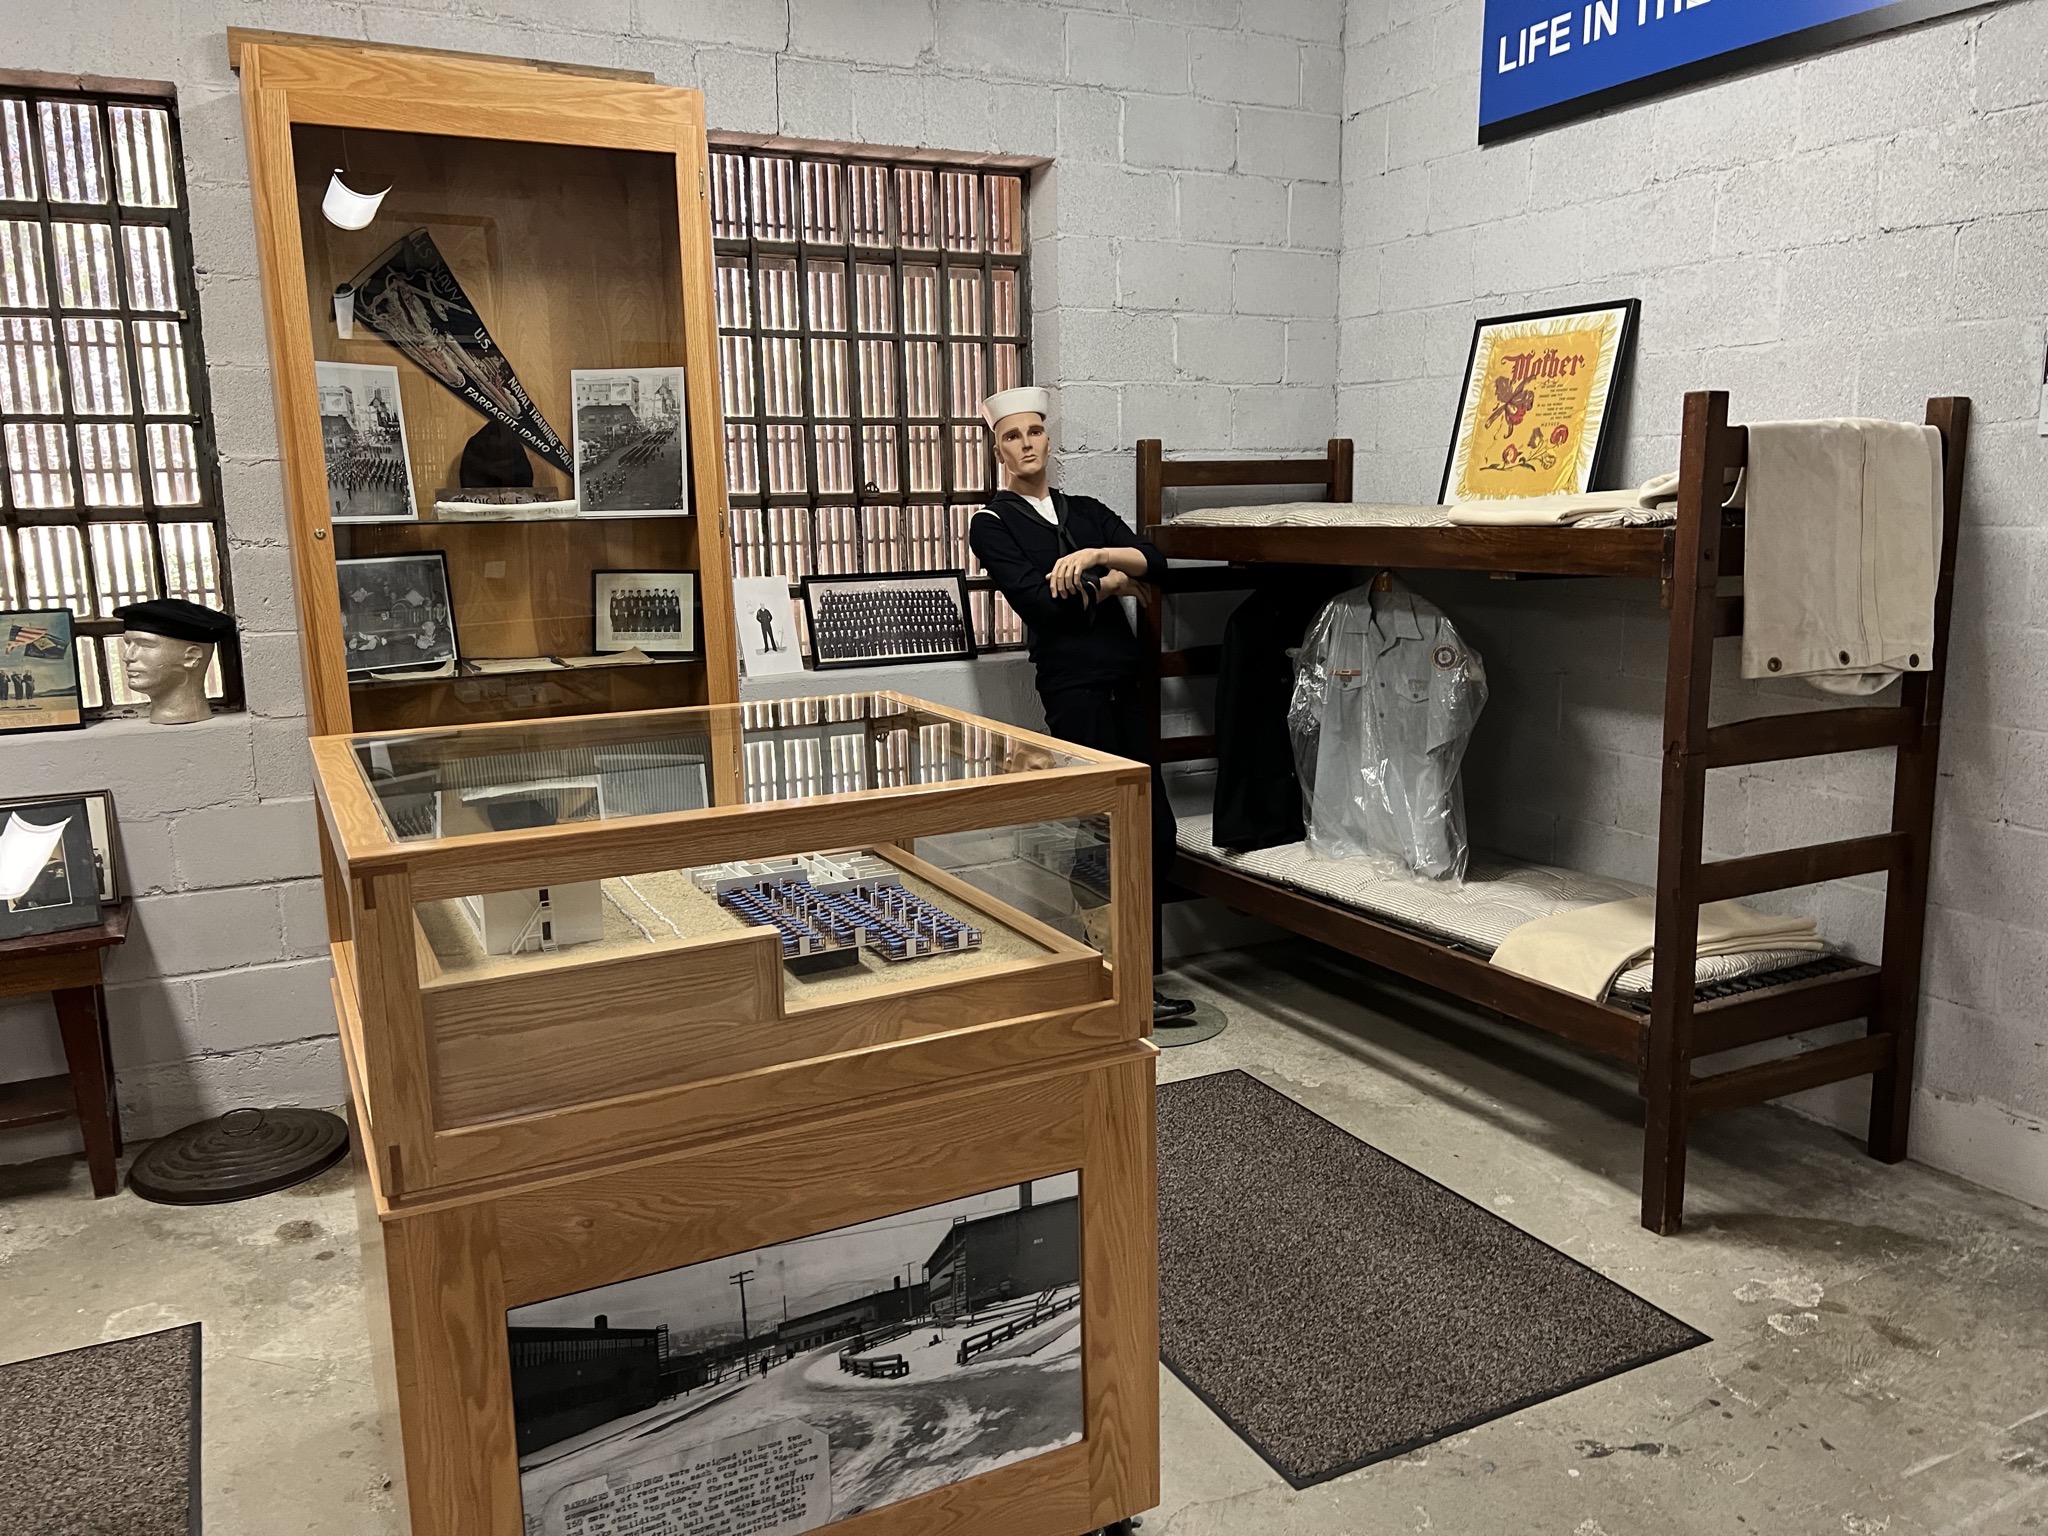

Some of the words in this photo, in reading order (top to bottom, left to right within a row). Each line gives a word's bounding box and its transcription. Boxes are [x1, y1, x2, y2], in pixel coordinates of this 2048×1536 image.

[1498, 11, 1572, 74] LIFE
[1583, 0, 1618, 46] IN
[430, 261, 463, 301] NAVY
[1501, 348, 1585, 384] Mother
[474, 327, 491, 353] U.S.
[507, 376, 531, 410] NAVAL
[529, 405, 559, 447] TRAINING
[518, 427, 550, 453] IDAHO
[620, 1493, 632, 1503] of
[690, 1469, 712, 1481] each
[717, 1452, 769, 1473] consisting
[773, 1446, 784, 1455] of
[787, 1438, 812, 1451] about
[669, 1468, 690, 1479] were
[695, 1453, 737, 1471] designed
[742, 1449, 752, 1457] to
[757, 1440, 782, 1452] house
[707, 1480, 733, 1492] There
[738, 1473, 759, 1483] were
[779, 1462, 790, 1470] of
[794, 1455, 818, 1466] these
[616, 1501, 638, 1513] with
[665, 1481, 702, 1498] company
[706, 1476, 718, 1484] on
[723, 1470, 738, 1479] the
[677, 1509, 698, 1521] with
[704, 1504, 719, 1513] the
[724, 1491, 755, 1506] center
[760, 1485, 771, 1494] of
[688, 1500, 702, 1509] the
[708, 1483, 755, 1503] perimeter
[760, 1477, 771, 1486] of
[709, 1510, 724, 1520] and
